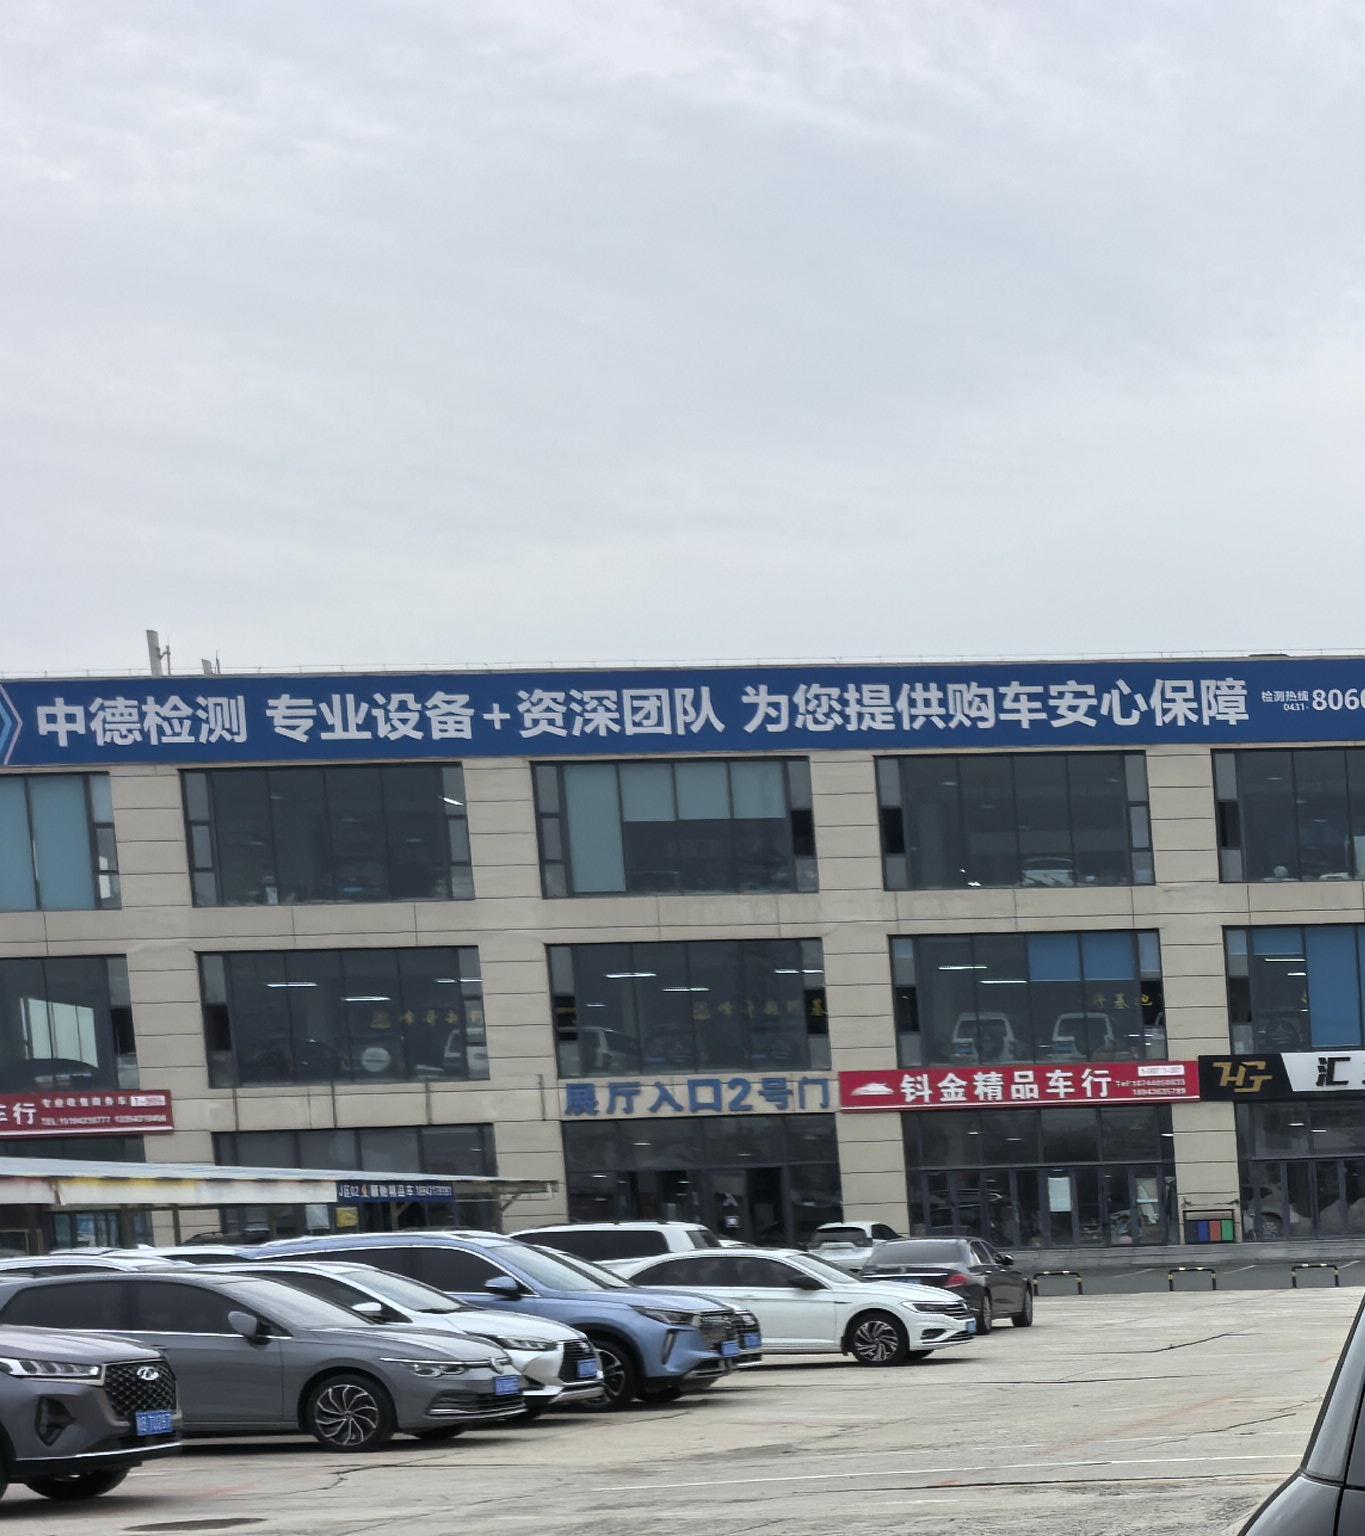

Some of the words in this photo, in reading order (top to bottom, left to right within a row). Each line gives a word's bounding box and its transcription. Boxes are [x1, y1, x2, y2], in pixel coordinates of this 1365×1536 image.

[36, 694, 248, 748] 中德检测
[265, 685, 725, 744] 专业设备+资深团队
[741, 677, 1250, 733] 为您提供购车安心保障
[564, 1076, 830, 1117] 展厅入口2号门
